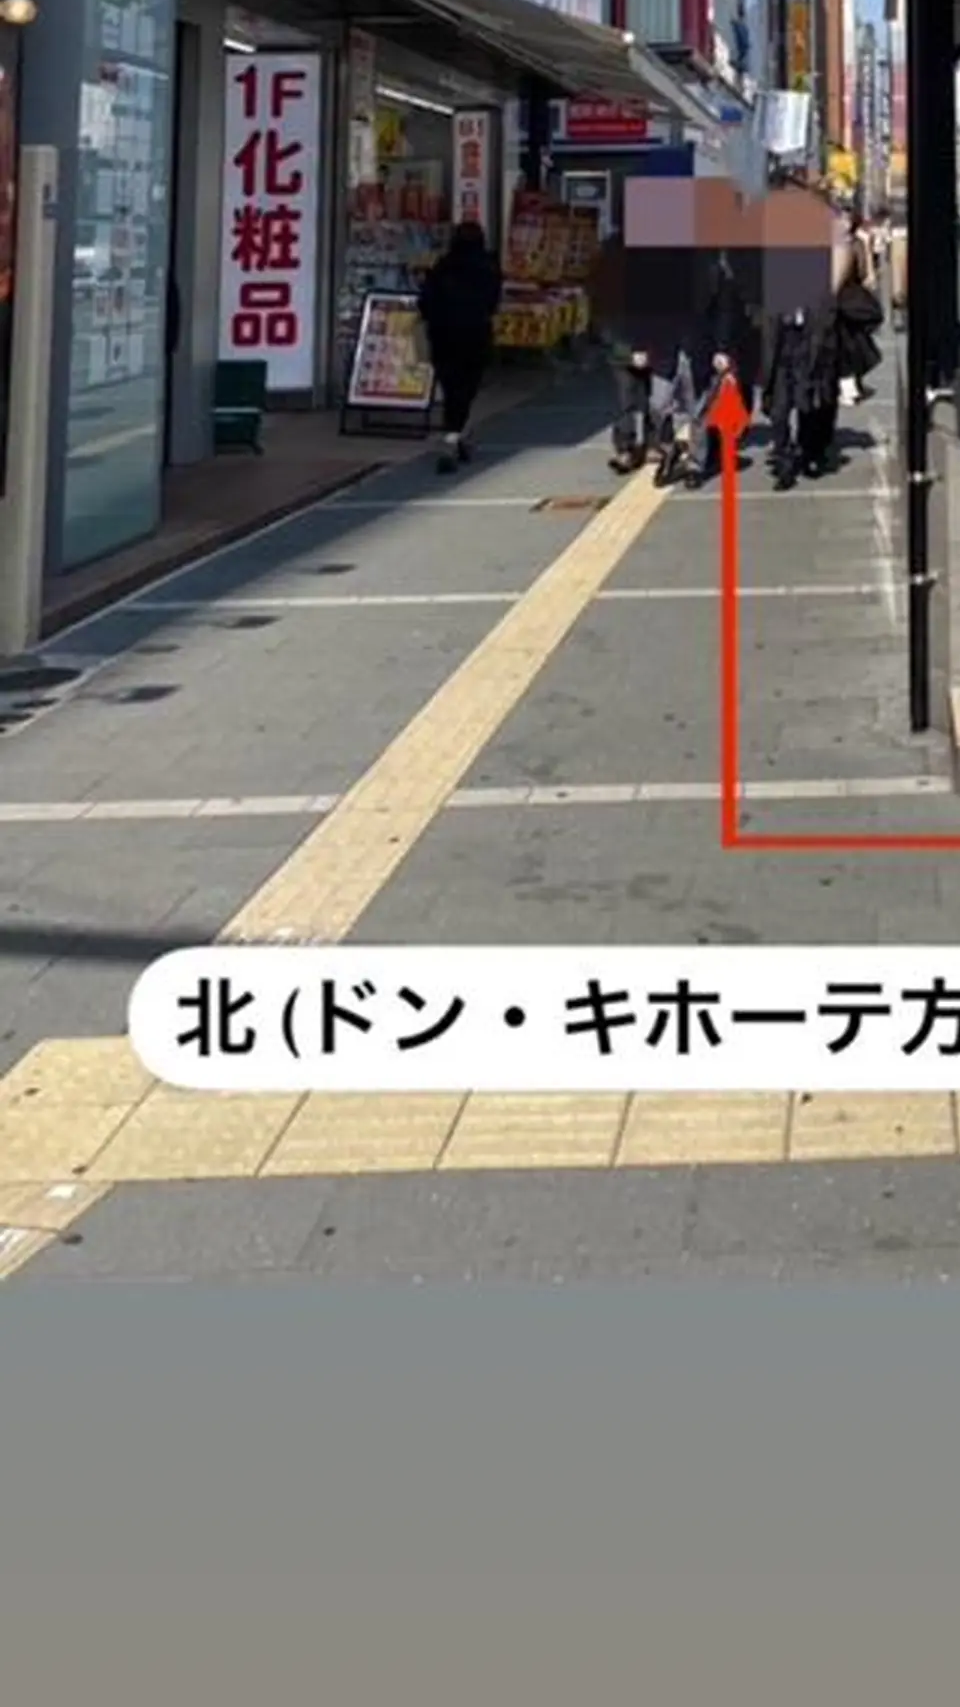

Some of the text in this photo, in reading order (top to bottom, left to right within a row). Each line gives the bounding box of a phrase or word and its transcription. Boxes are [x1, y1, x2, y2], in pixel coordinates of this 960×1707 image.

[234, 64, 307, 119] 1F
[231, 128, 303, 347] 化粧品
